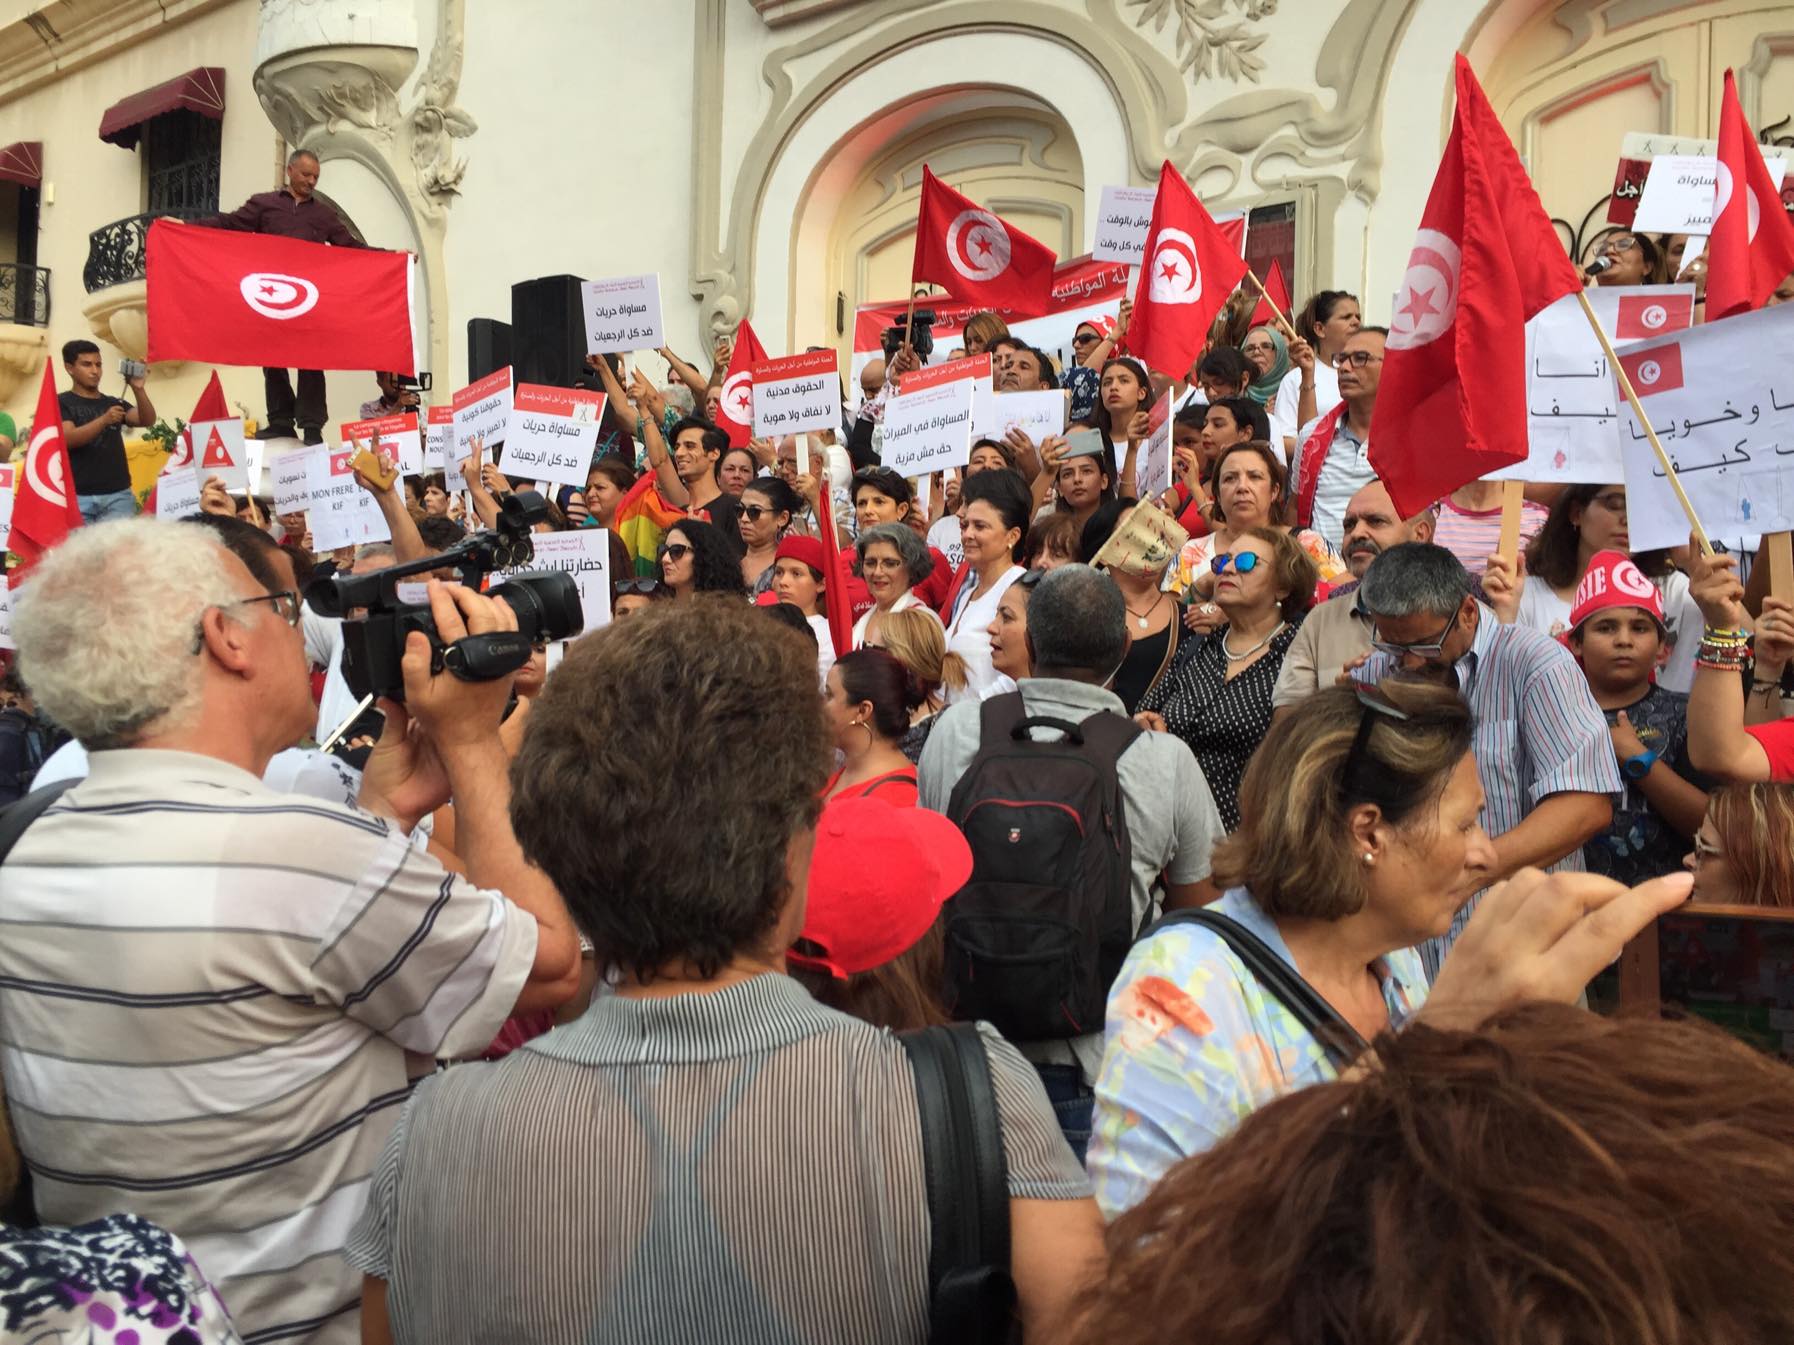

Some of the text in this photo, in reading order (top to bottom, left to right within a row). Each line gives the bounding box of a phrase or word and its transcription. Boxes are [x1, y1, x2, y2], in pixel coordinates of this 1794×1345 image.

[1119, 240, 1131, 251] كل
[596, 304, 647, 319] مساواة حريات
[594, 326, 653, 343] ضد كل الرجعيات
[766, 379, 824, 399] الحقوق مدنية
[763, 404, 831, 426] لا نفاق ولا هوية
[931, 409, 970, 430] المساواة
[522, 419, 581, 438] مساواة حريات
[884, 424, 912, 441] الميراث
[914, 419, 929, 434] في
[511, 448, 578, 468] ضد كل الرجعيات
[895, 442, 952, 466] حق مش مزية
[312, 489, 330, 500] MON
[332, 484, 354, 496] FRERE
[332, 498, 370, 511] KIF KIF
[561, 557, 603, 576] حضارتنا
